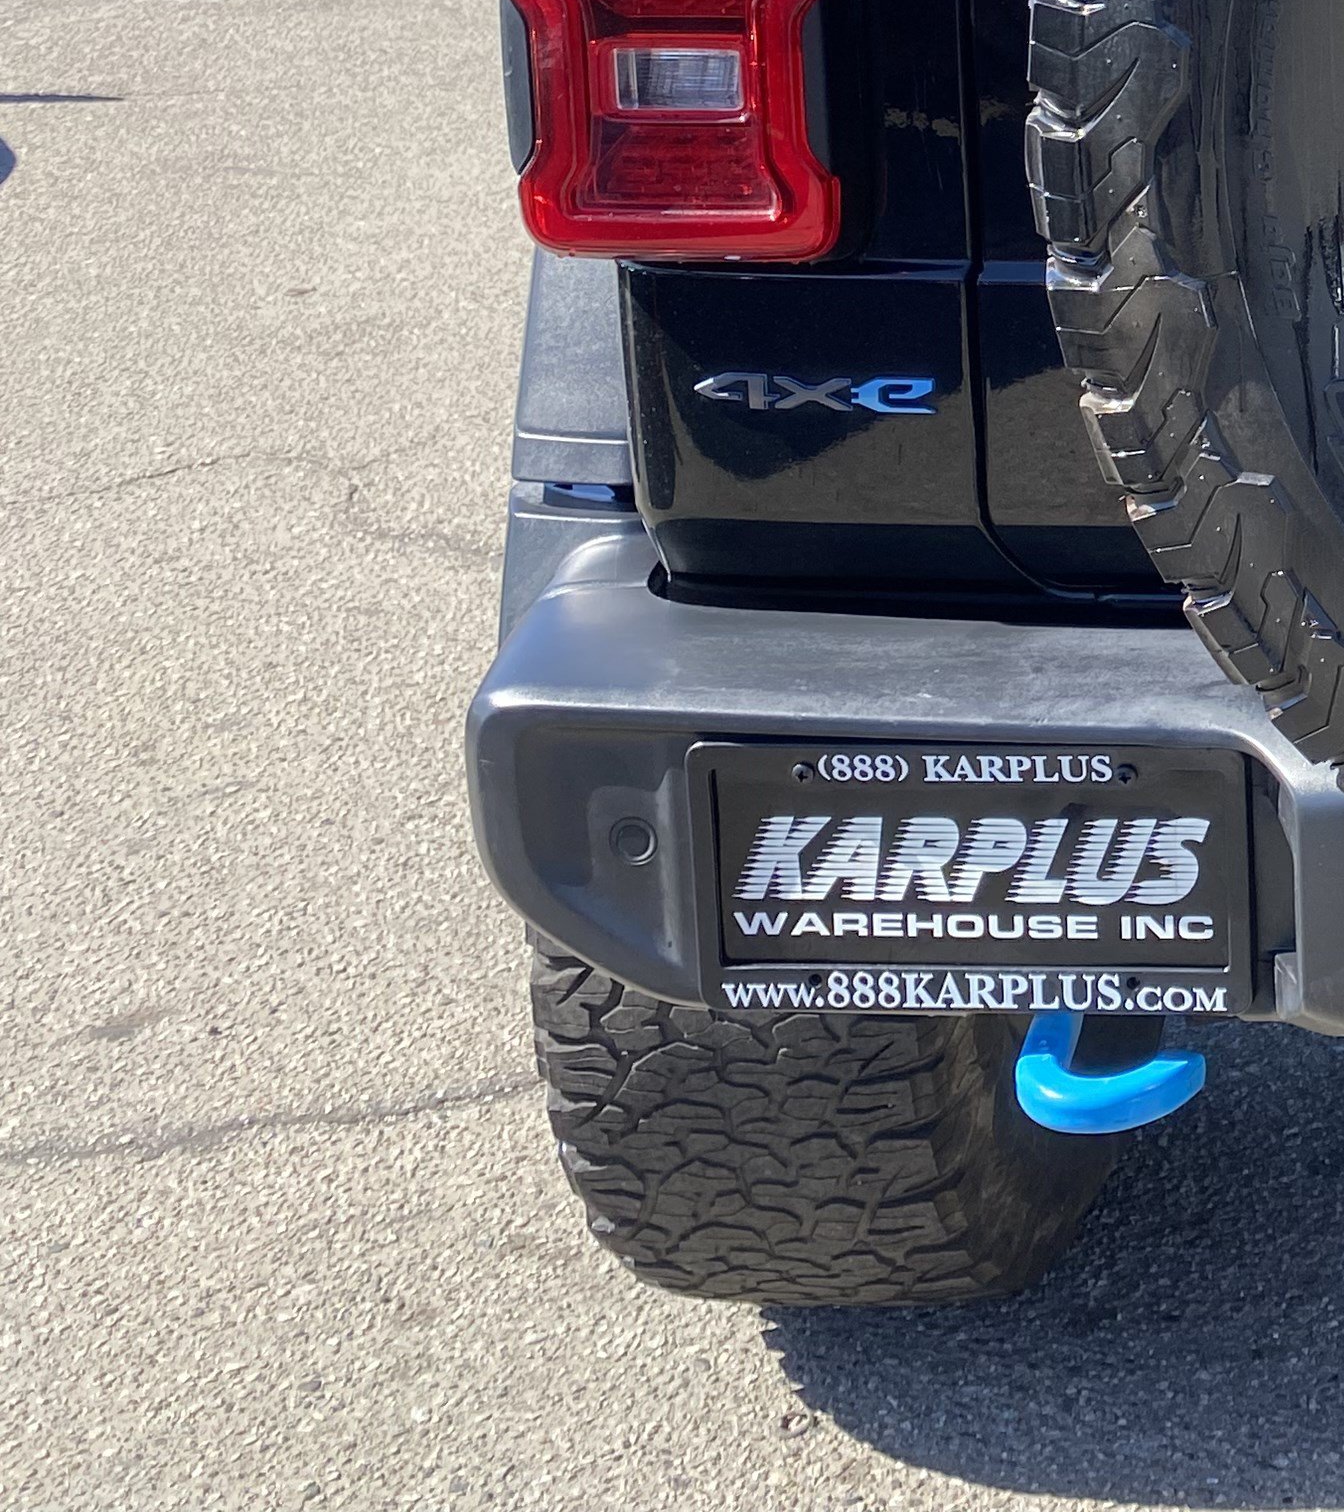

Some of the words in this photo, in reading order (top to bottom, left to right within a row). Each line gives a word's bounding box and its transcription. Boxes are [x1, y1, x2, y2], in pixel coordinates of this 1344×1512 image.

[816, 753, 909, 783] (888)
[924, 754, 1113, 784] KARPLUS
[732, 815, 1210, 906] KARPLUS
[733, 911, 1099, 941] WAREHOUSE
[1120, 914, 1215, 941] INC
